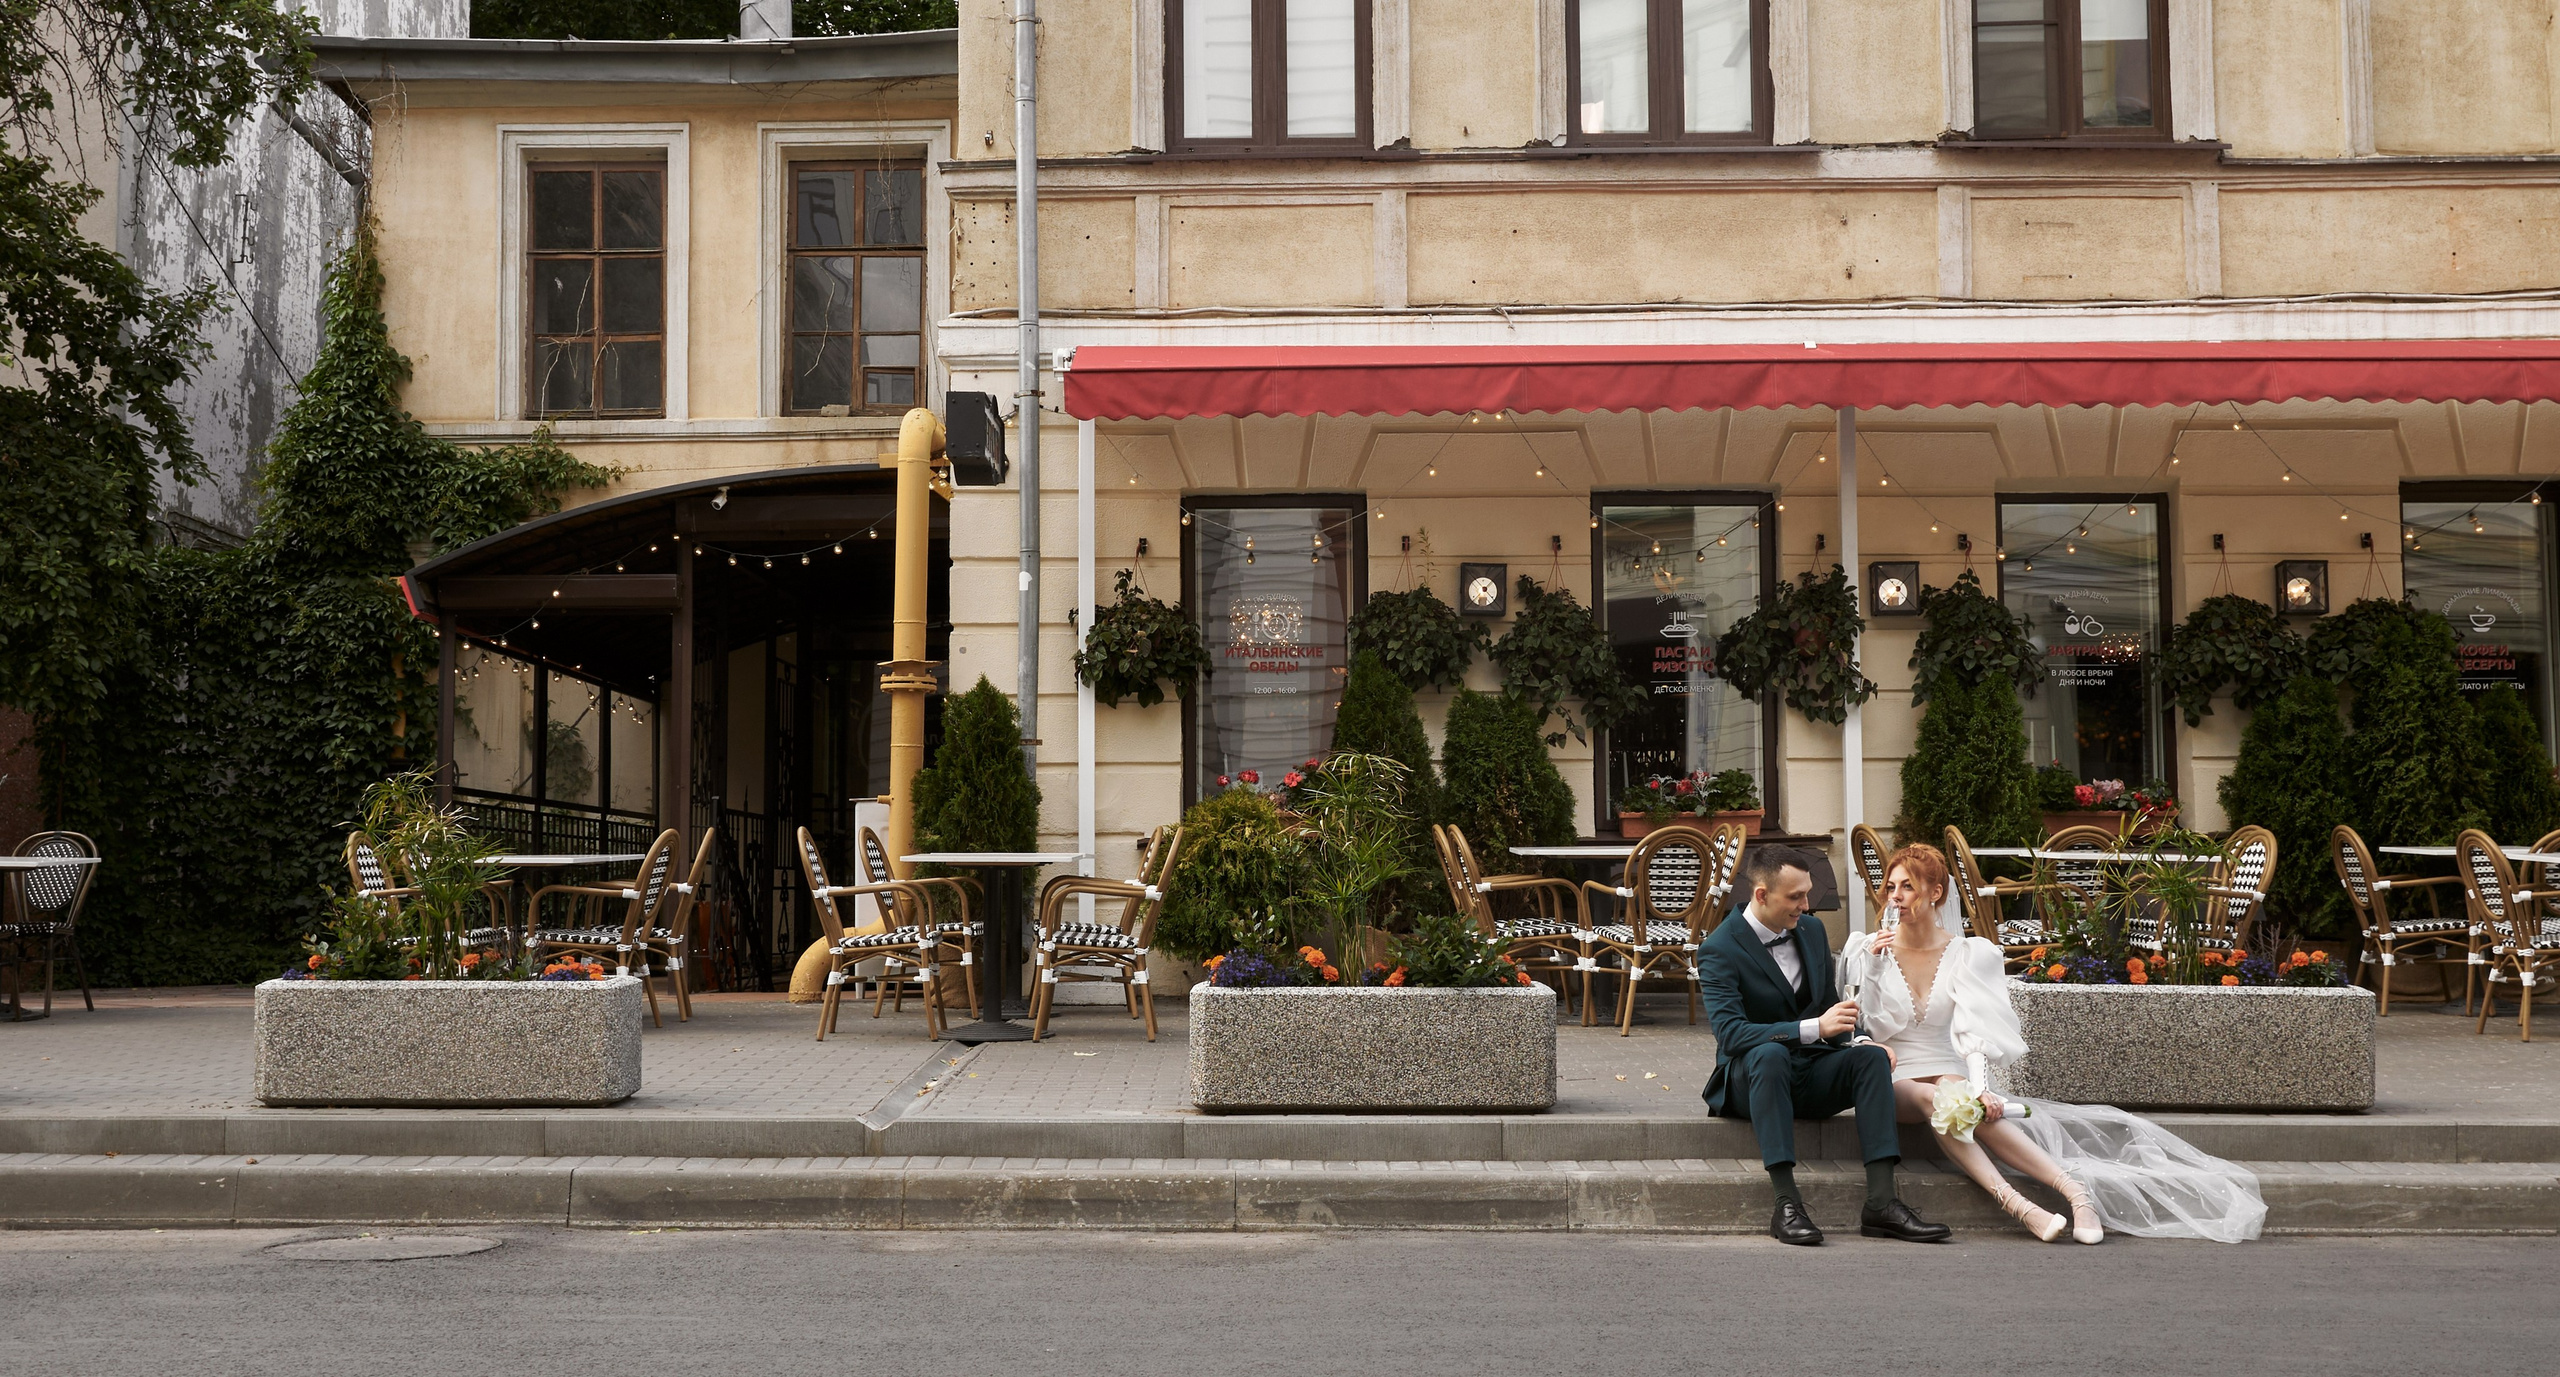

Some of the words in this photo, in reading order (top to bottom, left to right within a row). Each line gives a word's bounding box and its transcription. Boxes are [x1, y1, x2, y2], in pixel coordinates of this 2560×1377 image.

[1253, 594, 1265, 603] ПО
[1266, 593, 1298, 604] БУДНЯМ
[1655, 591, 1705, 605] ДЕЛИКАТЕСЫ
[2053, 589, 2089, 604] КАЖДЫЙ
[2090, 591, 2110, 604] ДЕНЬ
[2441, 587, 2480, 616] ДОМАШНИЕ
[2481, 587, 2523, 615] ЛИМОНАДЫ
[1225, 647, 1324, 659] ИТАЛЬЯНСКИЕ
[1655, 646, 1698, 658] ПАСТА
[1700, 646, 1711, 657] И
[2458, 644, 2496, 656] КОФЕ
[2499, 644, 2509, 656] И
[1250, 661, 1299, 674] ОБЕДЫ
[1652, 660, 1715, 673] РИЗОТТО
[2051, 669, 2057, 677] В
[2058, 669, 2086, 677] ЛЮБОЕ
[2087, 669, 2113, 677] ВРЕМЯ
[2059, 678, 2075, 687] ДНЯ
[2482, 682, 2489, 690] И
[1253, 686, 1272, 694] 12:00
[1278, 686, 1297, 694] 16:00
[1654, 685, 1688, 694] ДЕТСКОЕ
[1689, 685, 1714, 693] МЕНЮ
